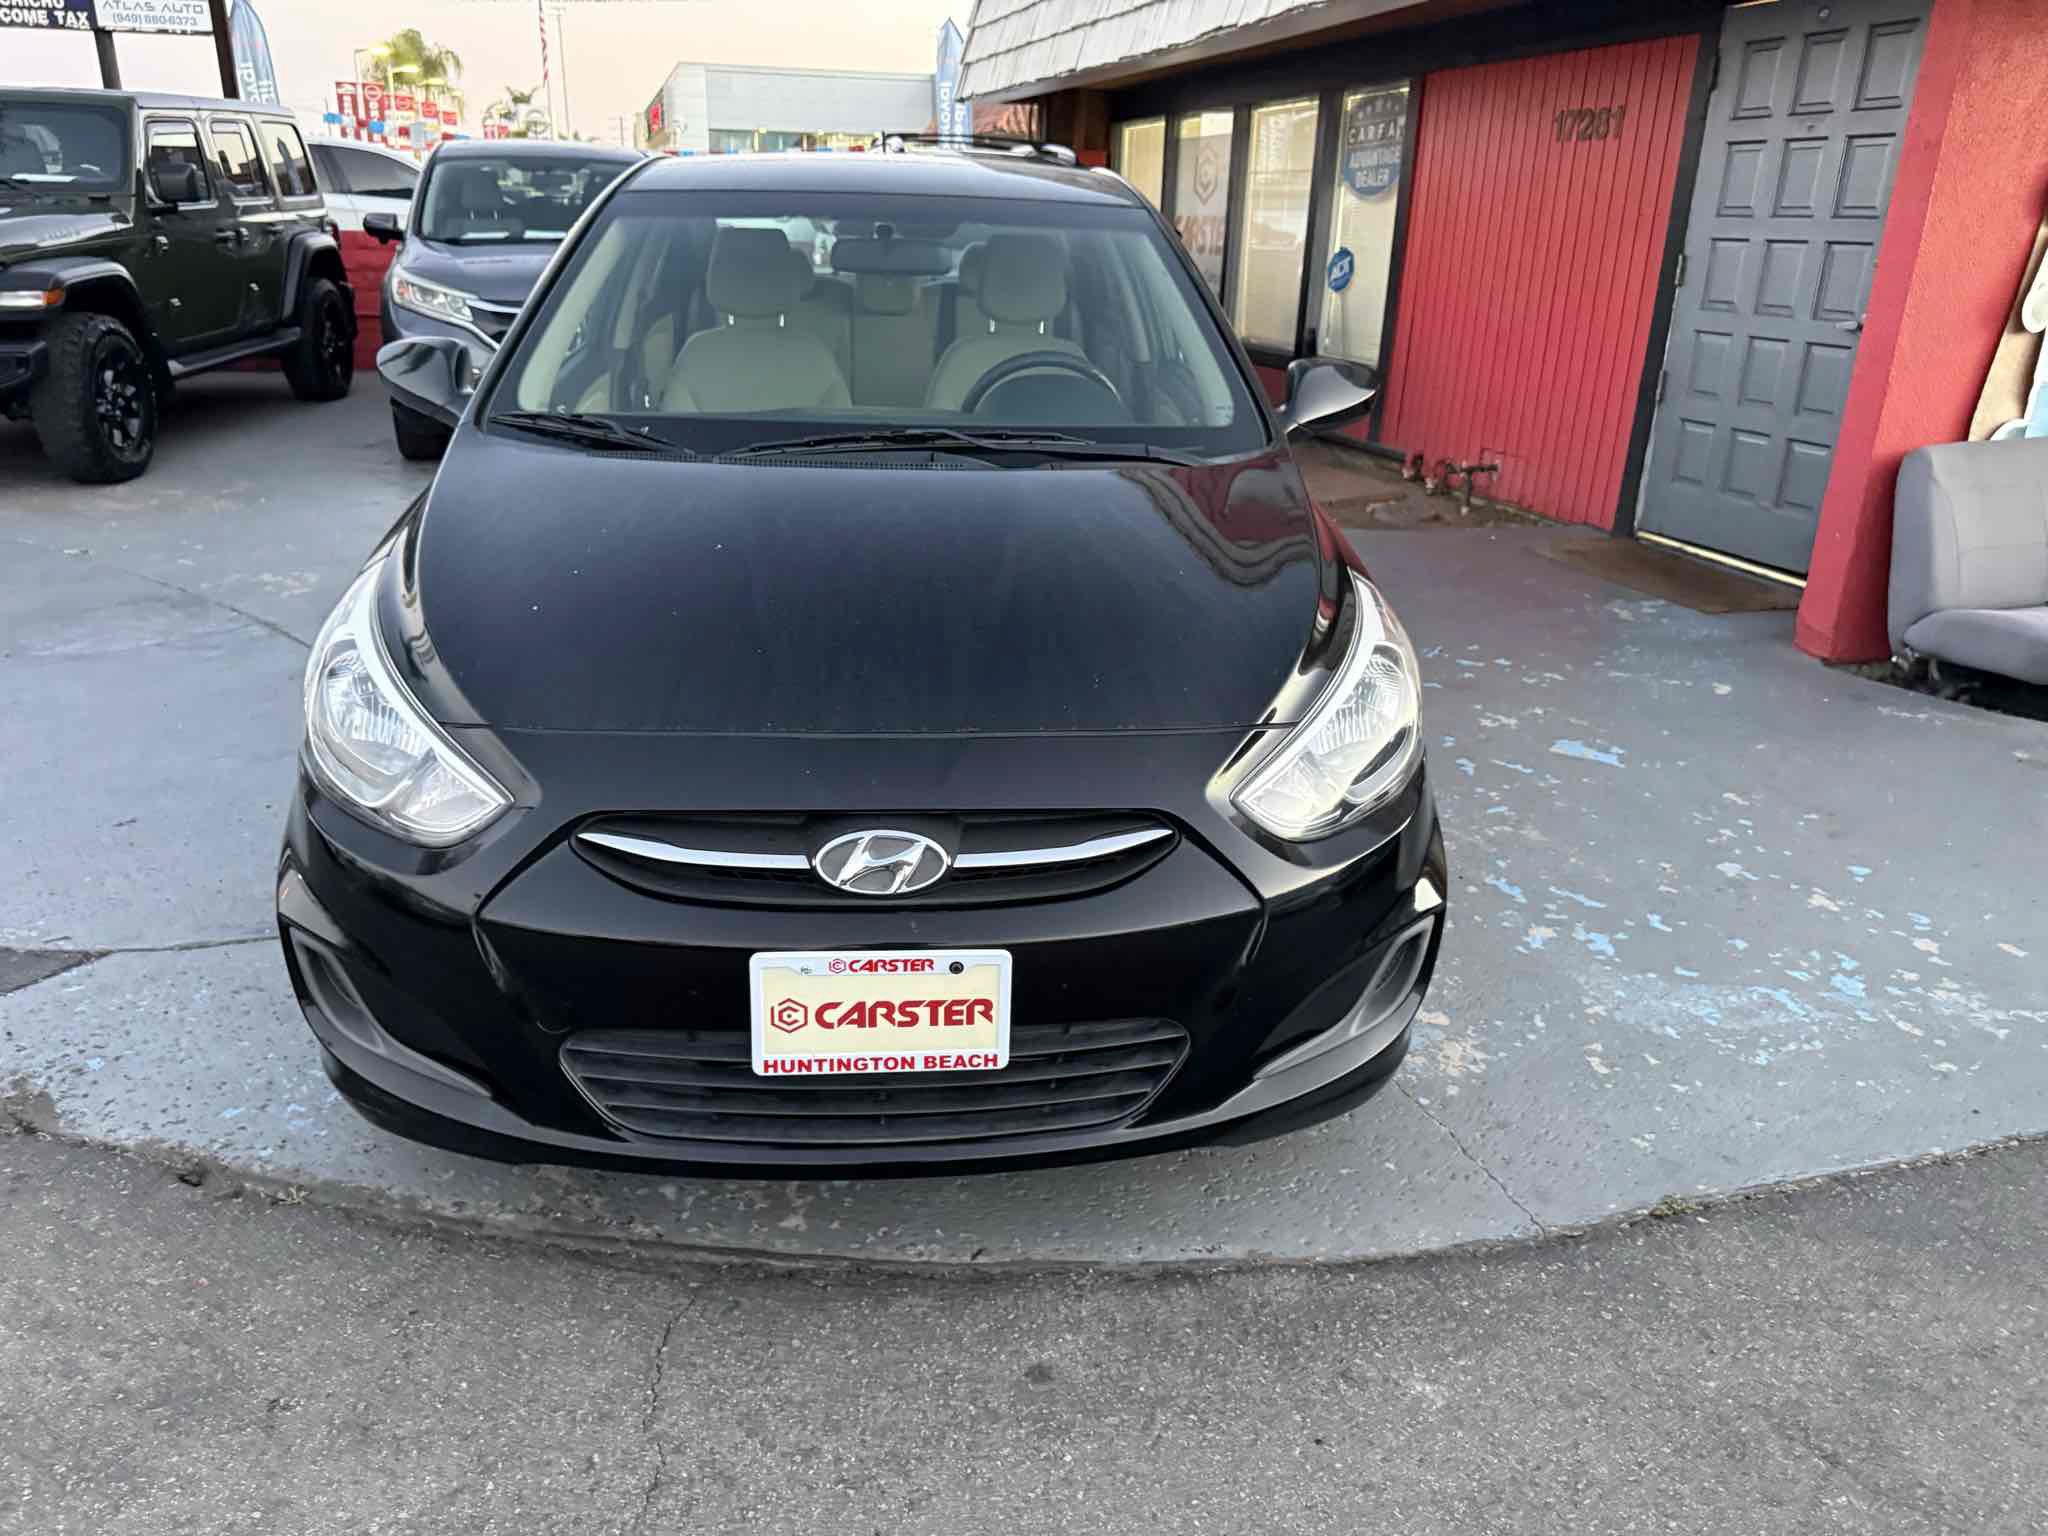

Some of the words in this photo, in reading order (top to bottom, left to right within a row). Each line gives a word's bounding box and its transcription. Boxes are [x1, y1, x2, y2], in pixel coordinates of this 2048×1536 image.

[103, 0, 155, 12] ATLAS
[161, 3, 204, 15] AUTO
[53, 10, 90, 29] TAX
[1331, 256, 1352, 281] ADT
[848, 958, 935, 972] CARSTER
[815, 997, 994, 1029] CARSTER
[763, 1055, 916, 1073] HUNTINGTON
[923, 1053, 998, 1069] BEACH
